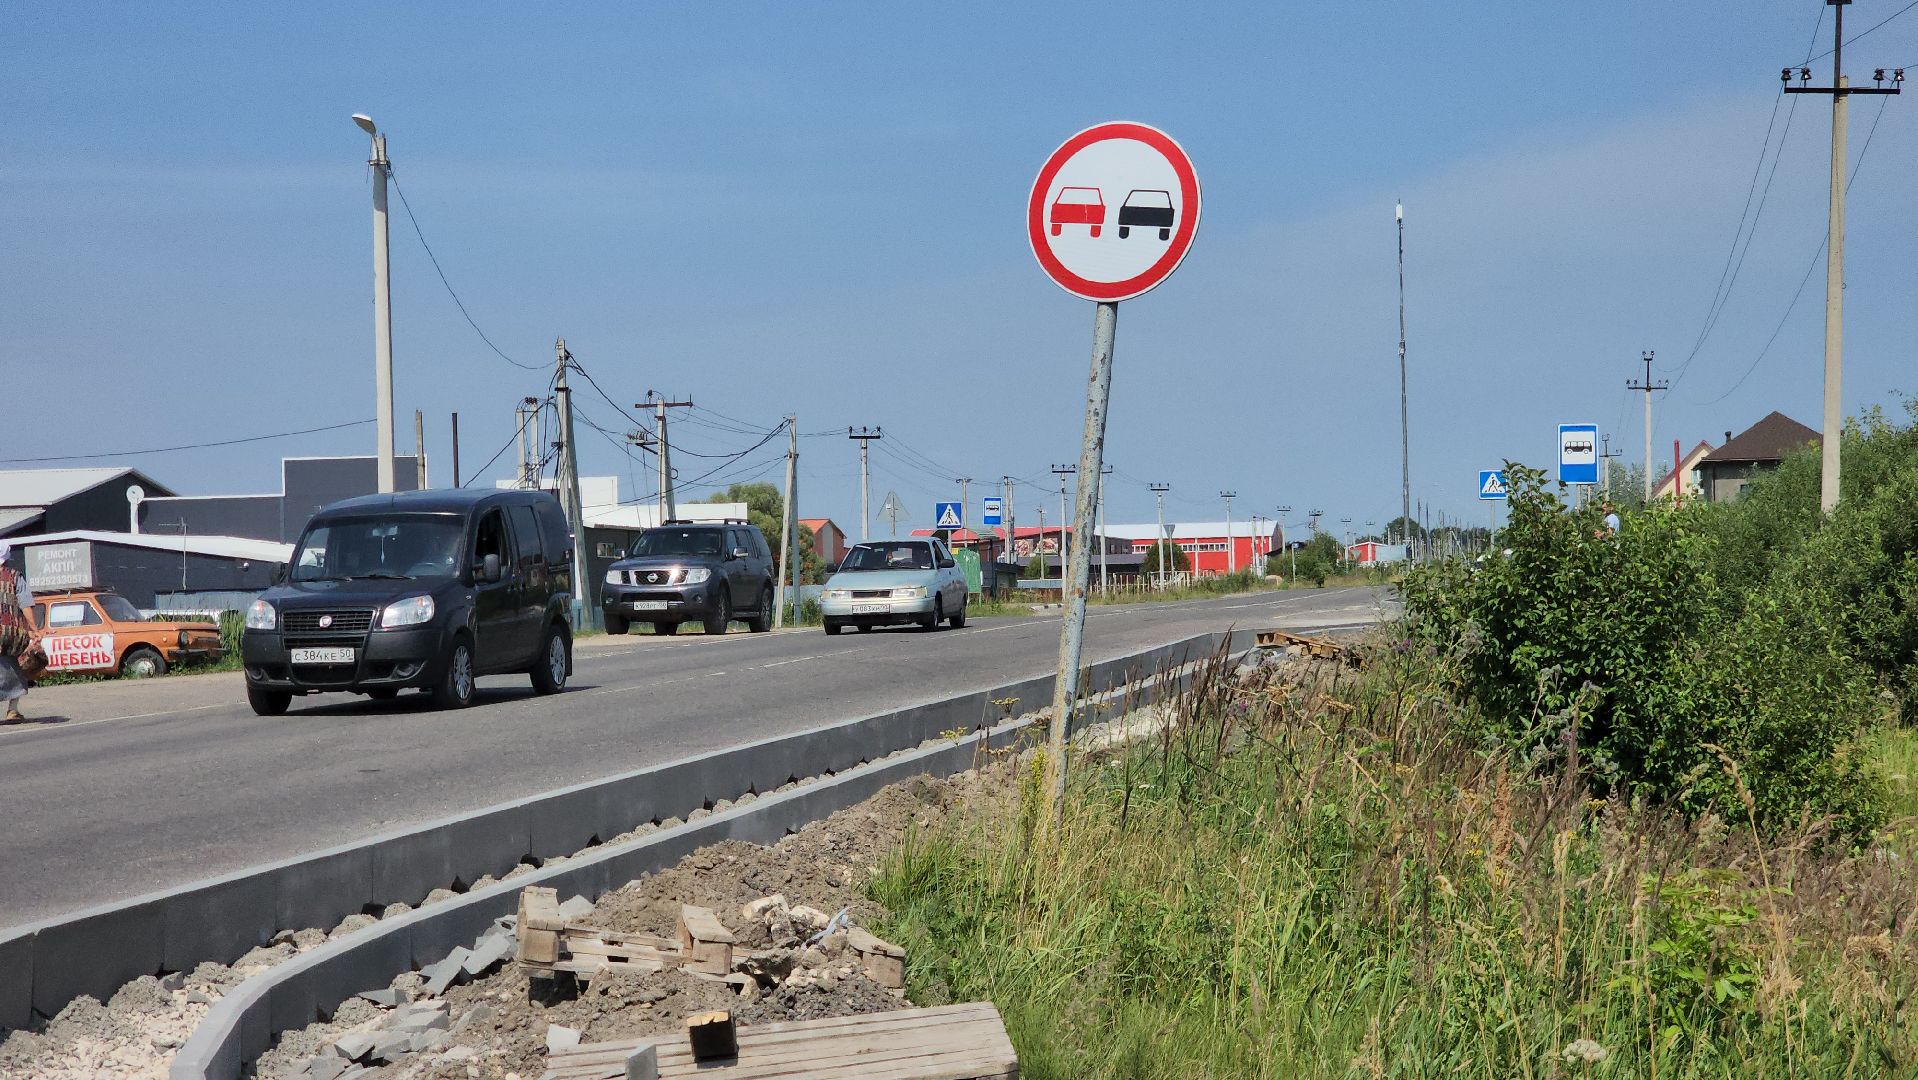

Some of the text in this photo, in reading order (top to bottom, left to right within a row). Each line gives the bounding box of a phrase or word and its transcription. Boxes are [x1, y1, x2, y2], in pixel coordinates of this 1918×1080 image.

[38, 549, 78, 560] РЕМОНТ
[43, 560, 75, 573] АКПП
[52, 636, 103, 652] ПЕСОК
